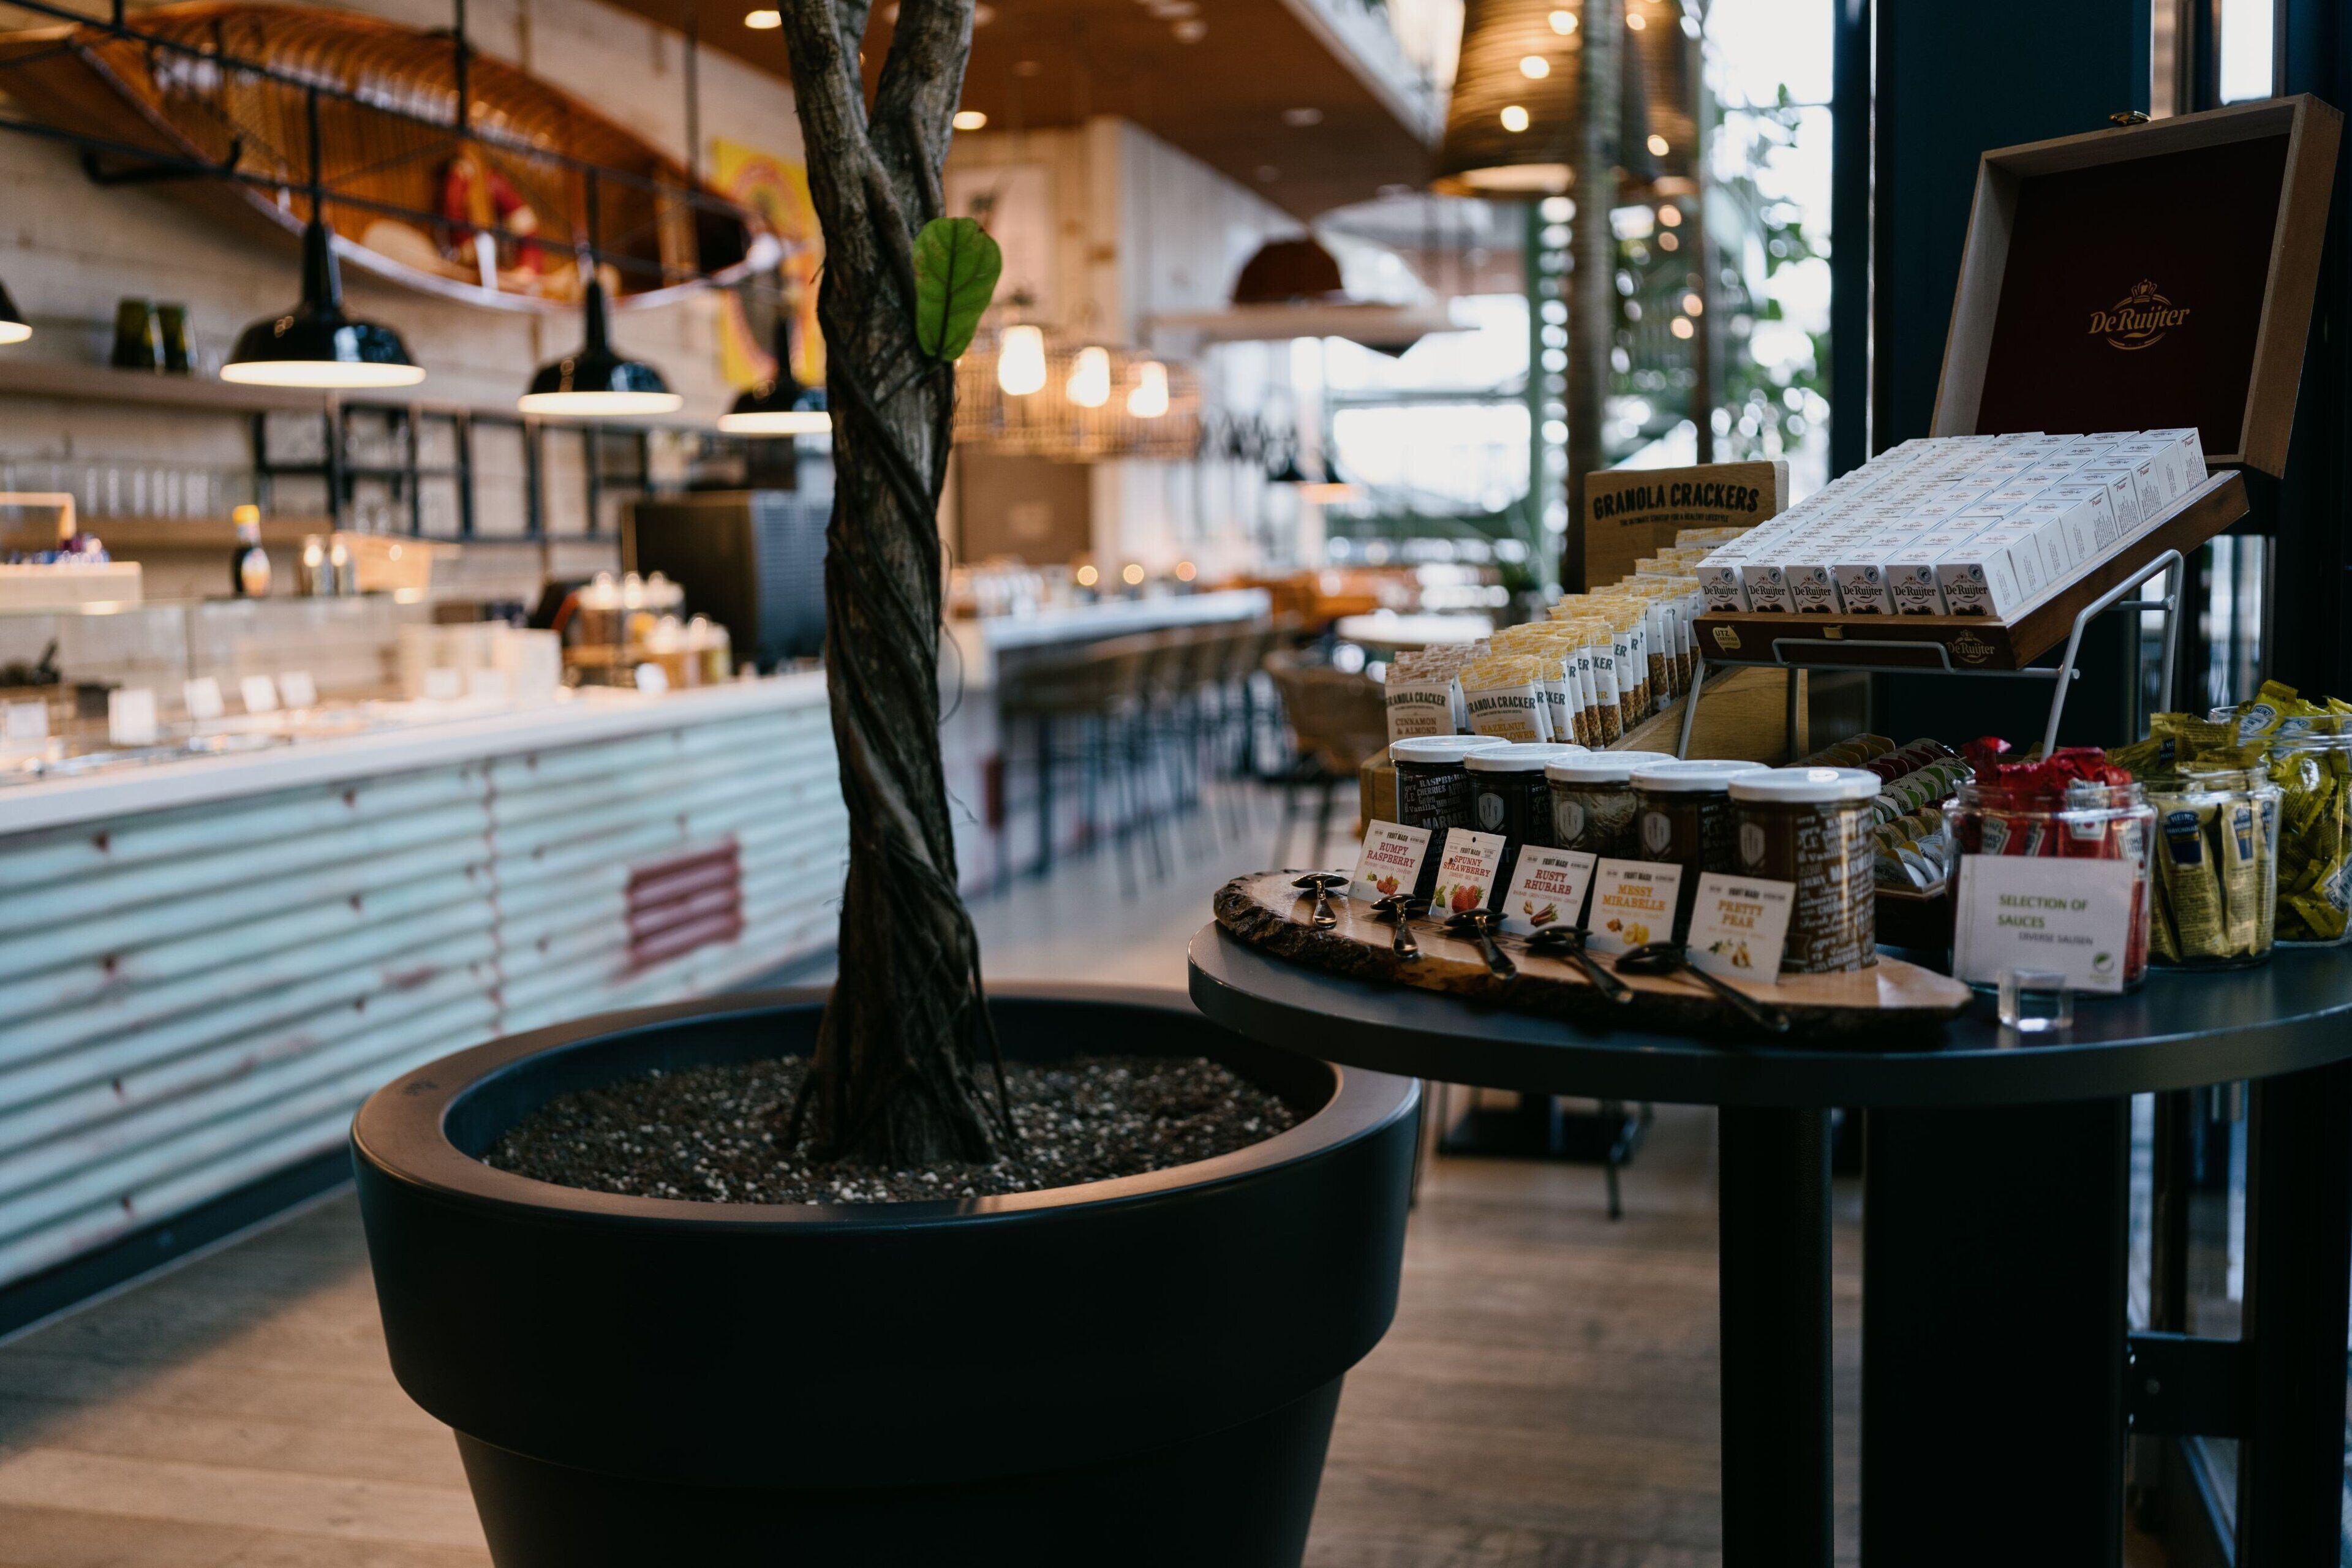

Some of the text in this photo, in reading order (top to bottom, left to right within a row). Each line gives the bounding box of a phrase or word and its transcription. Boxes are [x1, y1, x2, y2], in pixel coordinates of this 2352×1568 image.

[2087, 306, 2190, 338] De Ruijter
[1593, 483, 1759, 520] GRANOLA CRACKERS
[1703, 586, 1738, 597] De Ruijter
[1748, 586, 1785, 598] De Ruijter
[1793, 586, 1831, 599] De Ruijter
[1842, 585, 1883, 598] De Ruijter
[1893, 586, 1936, 599] De Ruijter
[1944, 584, 1988, 598] De Ruijter
[1960, 643, 1994, 658] Ruijter
[1415, 692, 1446, 706] CRACKER
[1497, 696, 1536, 709] CRACKER
[1395, 717, 1437, 725] CINNAMON
[1480, 722, 1525, 733] HAZELNUT
[1417, 785, 1446, 796] CHERRIES
[1409, 804, 1436, 813] Vanilla
[2171, 813, 2195, 822] HEINZ
[1387, 832, 1398, 840] FRUIT
[1379, 842, 1409, 855] RUMPY
[1367, 850, 1415, 867] RASPBERRY
[1454, 855, 1482, 867] SPUNNY
[1555, 859, 1569, 868] MASH
[1443, 862, 1491, 877] STRAWBERRY
[1535, 869, 1568, 882] RUSTY
[1524, 879, 1572, 894] RHUBARB
[1617, 884, 1654, 897] MESSY
[1602, 894, 1666, 911] MIRABELLE
[1999, 894, 2087, 910] SELECTION OF
[1998, 914, 2045, 928] SAUCES
